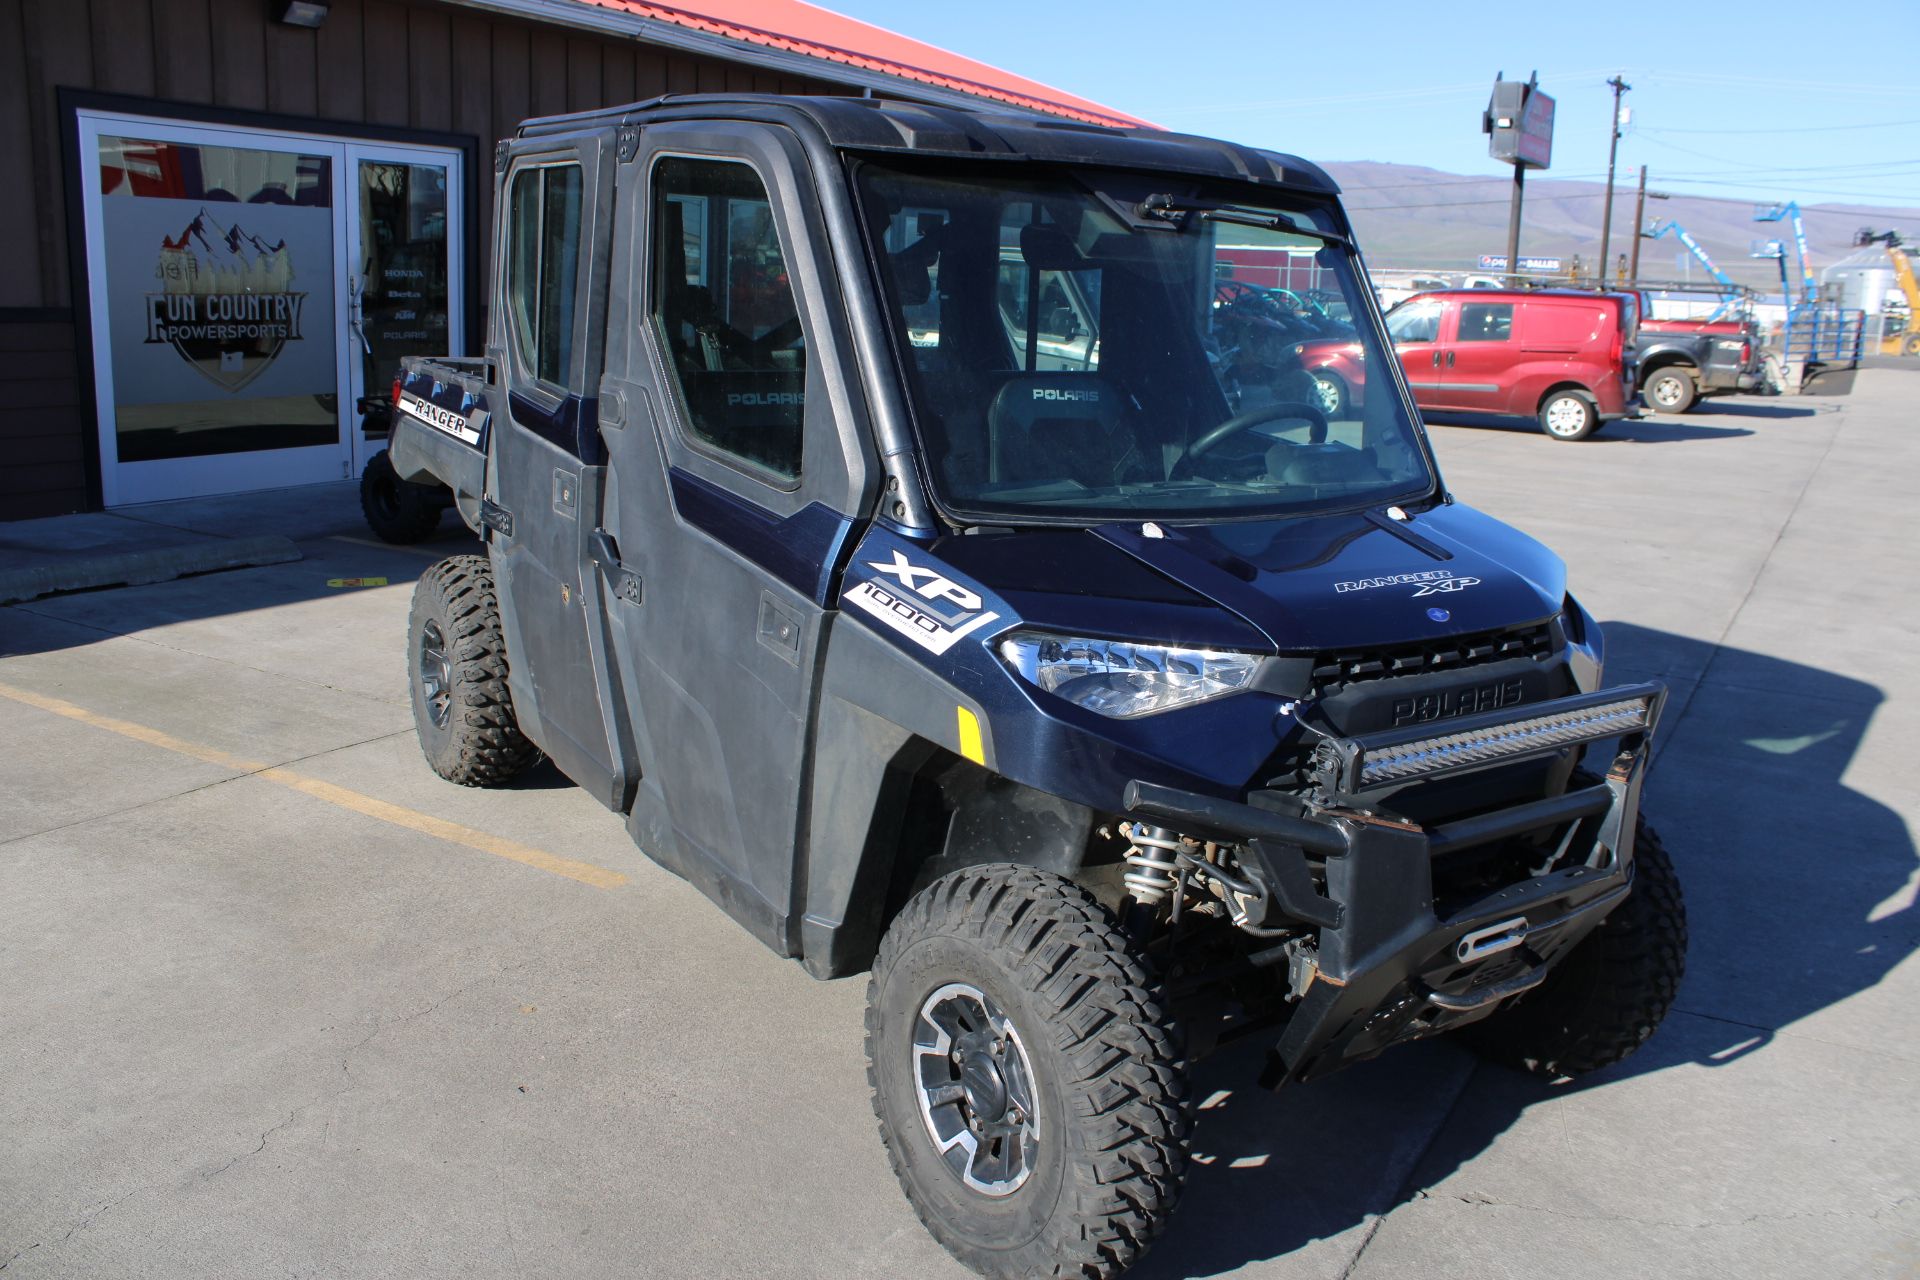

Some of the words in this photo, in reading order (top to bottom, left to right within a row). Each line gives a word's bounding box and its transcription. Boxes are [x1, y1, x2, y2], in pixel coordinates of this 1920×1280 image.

[384, 269, 424, 278] HONDA
[144, 293, 197, 343] FUN
[206, 292, 308, 339] COUNTRY
[168, 324, 288, 340] POWERSPORTS
[383, 331, 428, 340] POLARIS
[727, 393, 806, 406] POLARIS
[1032, 388, 1099, 401] POLARIS
[414, 398, 466, 434] RANGER
[862, 549, 984, 613] XP
[1334, 570, 1454, 593] RANGER
[1411, 576, 1481, 598] XP
[862, 583, 941, 634] 1000
[1394, 679, 1523, 727] POLARIS
